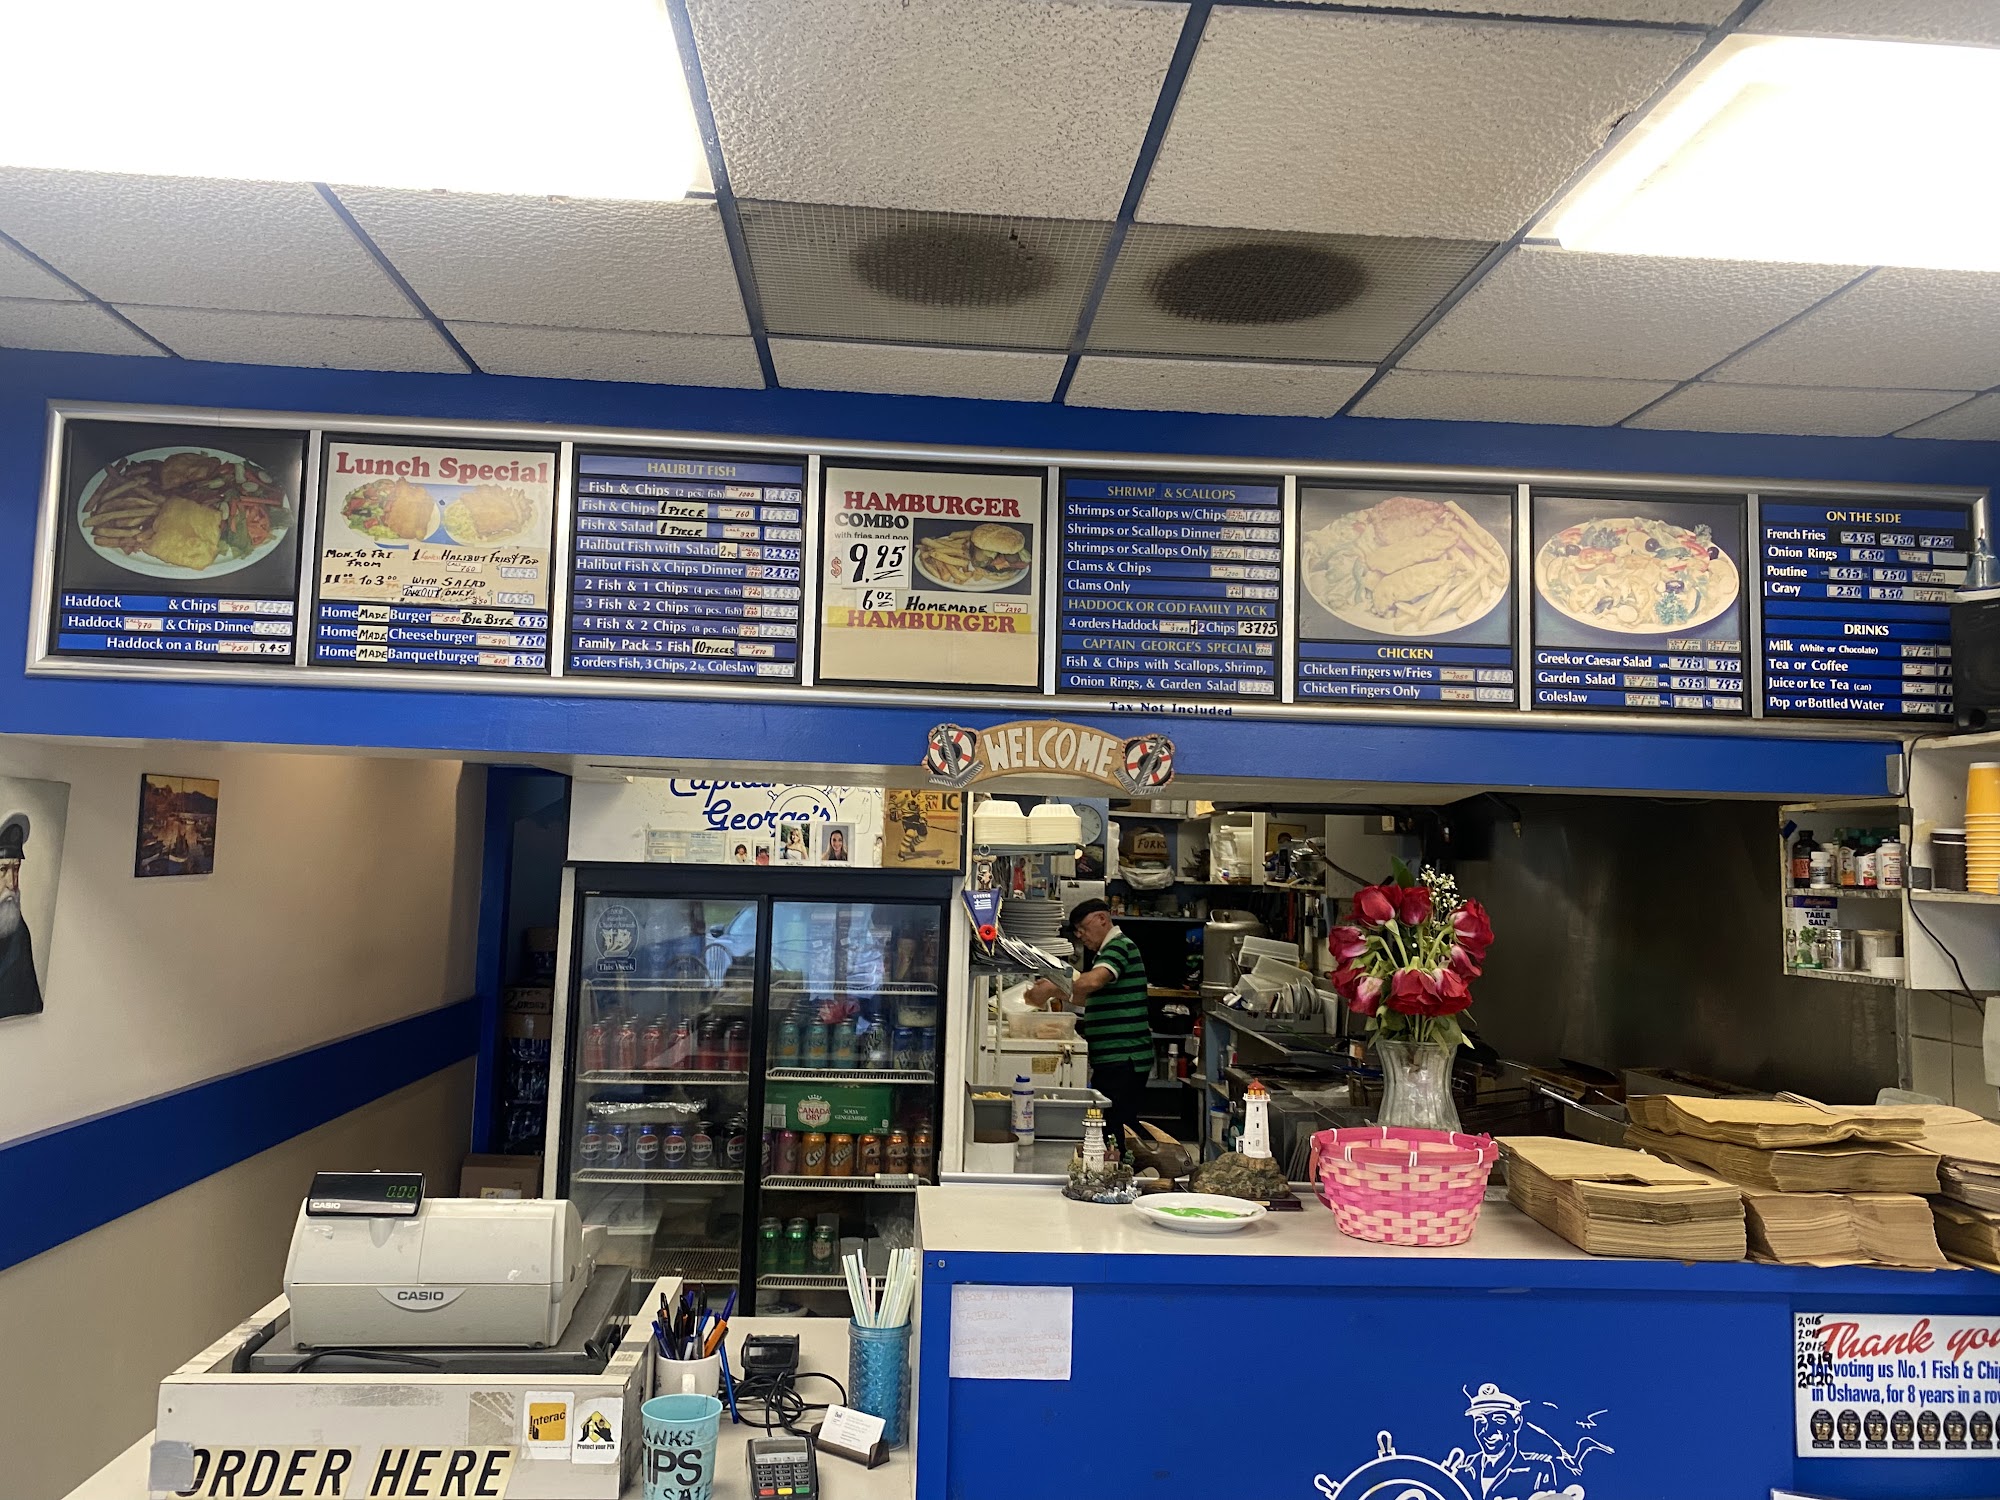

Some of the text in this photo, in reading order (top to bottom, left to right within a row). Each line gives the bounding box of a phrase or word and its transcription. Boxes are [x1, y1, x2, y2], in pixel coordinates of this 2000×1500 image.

[336, 452, 548, 484] Lunch Special
[648, 463, 736, 476] HALIBUT FISH
[589, 482, 725, 498] Fish & Chips (2 pcs. fish)
[1108, 486, 1235, 500] SHRIMP & SCALLOPS
[843, 491, 1021, 517] HAMBURGER
[835, 512, 909, 529] COMBO
[1068, 504, 1226, 522] Shrimps or Scallops w/Chips
[1827, 511, 1901, 524] ON THE SIDE
[1767, 529, 1826, 541] French Fries
[580, 538, 718, 555] Halibut Fish with Salad
[1768, 546, 1837, 560] Onion Rings
[346, 559, 381, 567] FROM
[441, 550, 487, 562] HALIBUT
[831, 557, 842, 578] $
[412, 576, 486, 587] WITH SALAD
[65, 596, 217, 612] Haddock & Chips
[862, 590, 873, 610] 6
[905, 596, 987, 614] HOMEMADE
[1069, 600, 1267, 615] HADDOCK OR COD FAMILY PACK
[321, 607, 513, 626] Home MADE Burger BIG BITE
[847, 610, 1016, 633] HAMBURGER
[320, 626, 474, 644] Home MADE Cheeseburger
[1844, 624, 1889, 636] DRINKS
[106, 637, 219, 651] Haddock on a Bun
[579, 638, 690, 652] Family Pack 5 Fish
[1083, 639, 1254, 653] CAPTAIN GEORGE'S SPECIAL
[1377, 648, 1433, 659] CHICKEN
[1538, 653, 1652, 667] Greek or Caesar Salad
[573, 658, 579, 667] 5
[581, 658, 617, 668] orders
[618, 659, 643, 670] Fish,
[645, 660, 652, 670] 3
[654, 660, 688, 672] Chips,
[689, 662, 697, 671] 2
[707, 662, 755, 673] Coleslaw
[1303, 664, 1433, 680] Chicken Fingers w/Fries
[1768, 678, 1795, 689] Juice
[1796, 680, 1808, 689] or
[1810, 679, 1826, 689] Ice
[1830, 679, 1849, 690] Tea
[1539, 691, 1587, 702] Coleslaw
[1770, 697, 1884, 710] Pop or Bottled Water
[1109, 701, 1232, 716] Tax Not Included
[984, 727, 1118, 778] WELCOME
[1137, 837, 1167, 849] FORKS
[798, 1107, 830, 1115] CANADA
[397, 1290, 444, 1302] CASIO
[1815, 1318, 1935, 1359] Thank
[1834, 1359, 1874, 1382] voting
[1878, 1364, 1893, 1378] us
[1898, 1360, 1927, 1379] No.1
[1933, 1360, 1959, 1379] Fish
[1964, 1361, 1973, 1379] &
[1812, 1386, 1823, 1401] in
[1828, 1383, 1884, 1404] Oshawa,
[1886, 1384, 1903, 1402] for
[1908, 1385, 1916, 1402] 8
[1919, 1389, 1955, 1407] years
[1958, 1385, 1970, 1403] in
[1974, 1390, 1981, 1403] a
[530, 1412, 566, 1430] Interac
[175, 1448, 512, 1499] ORDER HERE
